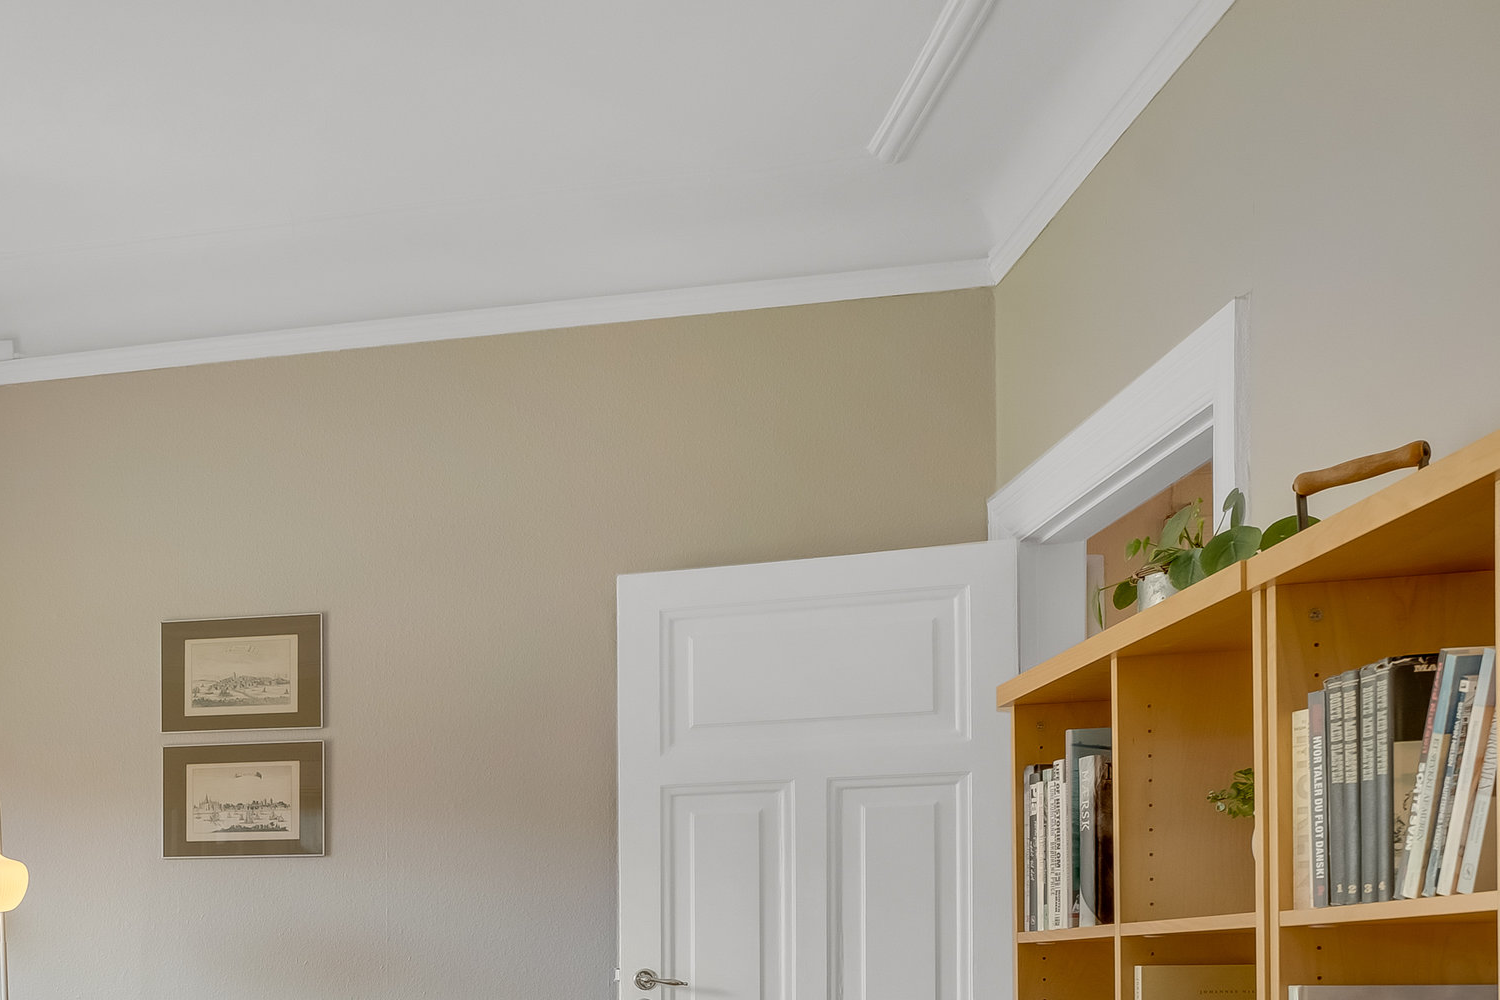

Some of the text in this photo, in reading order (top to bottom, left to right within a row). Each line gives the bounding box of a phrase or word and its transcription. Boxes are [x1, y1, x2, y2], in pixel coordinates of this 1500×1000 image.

[1330, 691, 1344, 720] BORTE
[1344, 690, 1358, 720] BORTE
[1362, 686, 1374, 714] BORTE
[1331, 720, 1344, 742] MED
[1344, 720, 1358, 742] MED
[1362, 717, 1374, 738] MED
[1377, 710, 1388, 732] MED
[1312, 736, 1324, 839] HVOR TALER DU FLOT
[1080, 770, 1090, 832] MÆRSK
[1336, 884, 1344, 894] 1
[1348, 884, 1358, 894] 2
[1364, 883, 1372, 894] 3
[1378, 880, 1386, 890] 4
